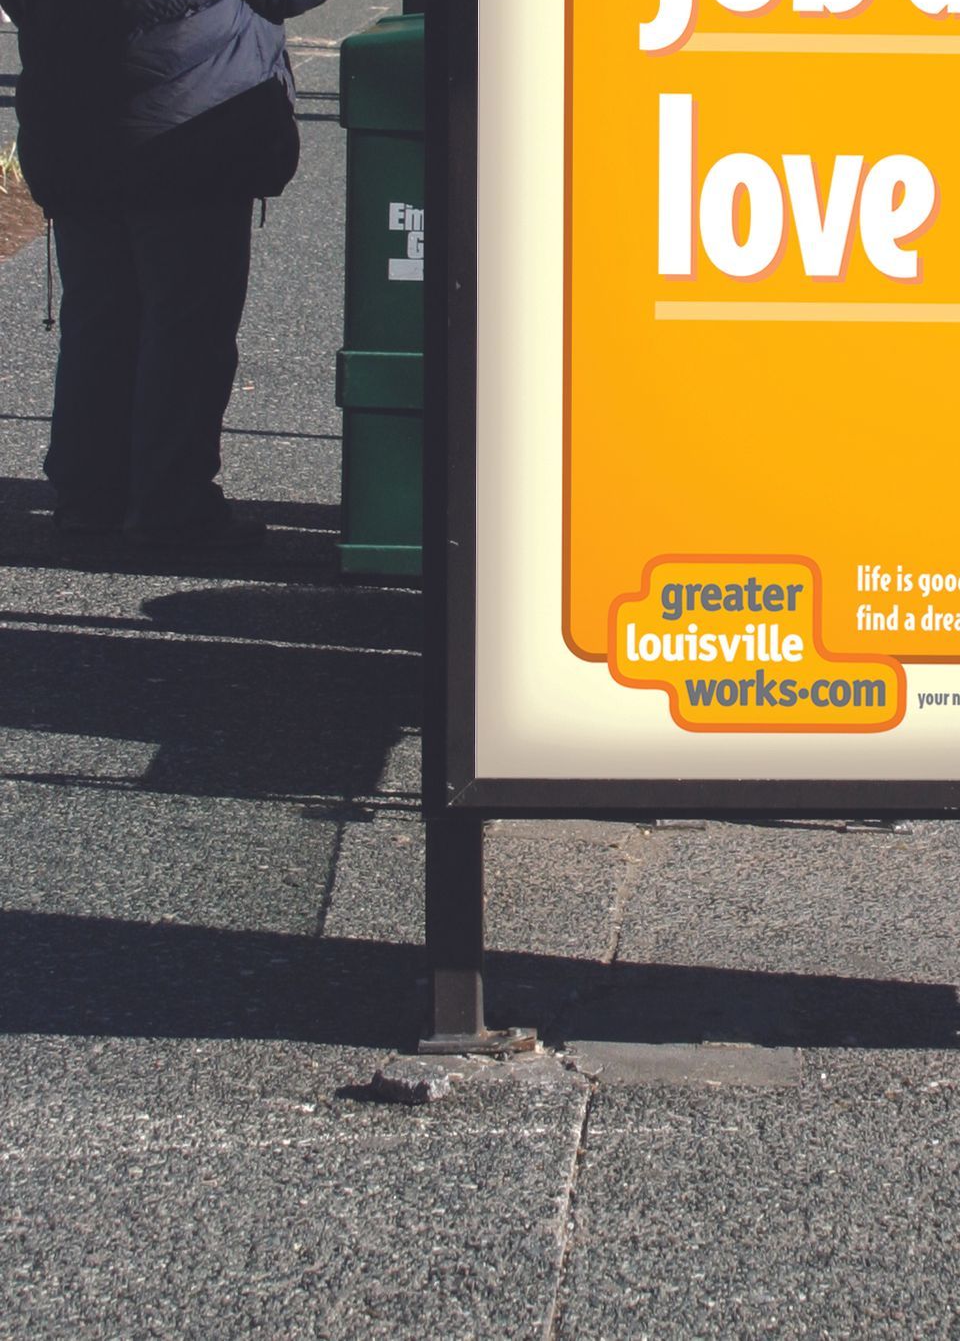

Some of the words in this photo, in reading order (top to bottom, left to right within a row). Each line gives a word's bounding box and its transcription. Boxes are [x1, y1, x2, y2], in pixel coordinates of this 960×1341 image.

[658, 93, 937, 280] love
[857, 564, 891, 592] life
[897, 564, 914, 592] is
[661, 577, 804, 621] greater
[856, 604, 899, 632] find
[904, 612, 916, 632] a
[626, 623, 804, 662] louisville
[918, 690, 950, 709] your
